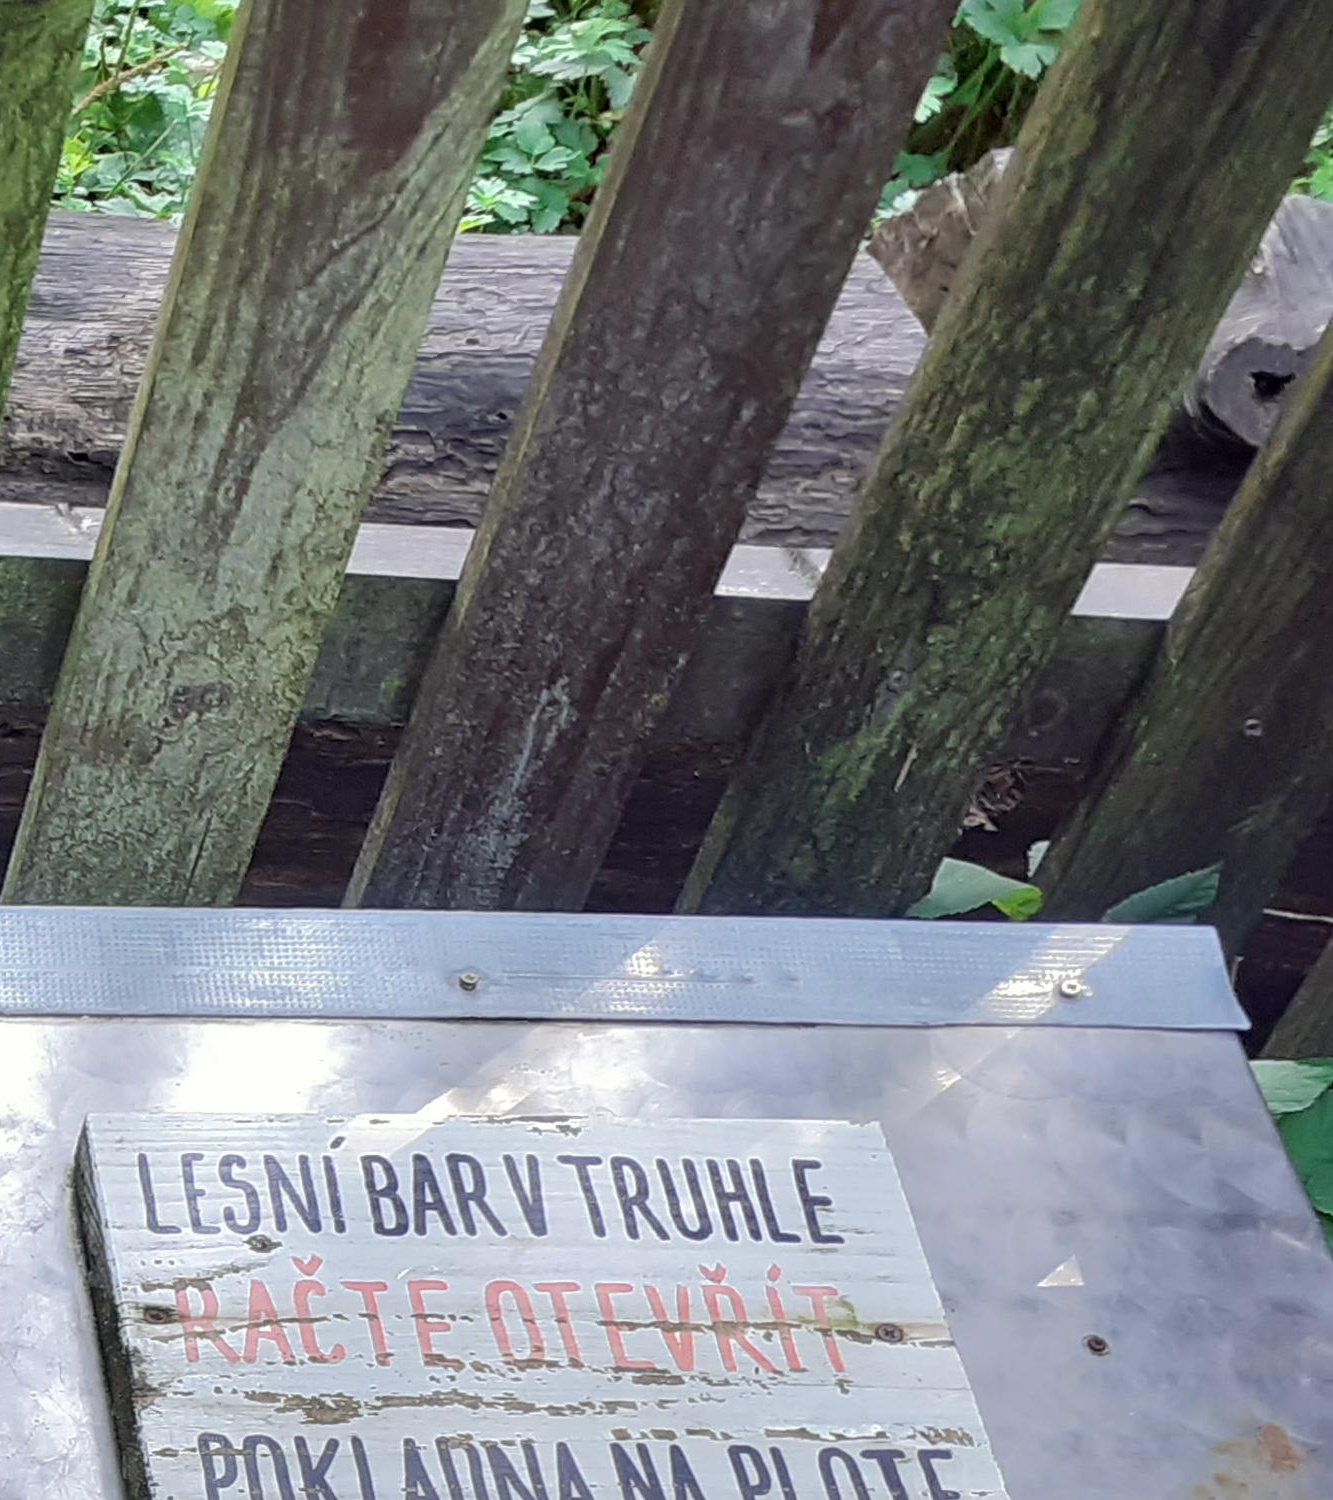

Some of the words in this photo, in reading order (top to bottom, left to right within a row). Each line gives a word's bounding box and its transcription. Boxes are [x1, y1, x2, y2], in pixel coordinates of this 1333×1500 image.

[138, 1135, 346, 1236] LESNÍ
[360, 1153, 507, 1238] BAR
[505, 1153, 550, 1238] V
[557, 1154, 845, 1245] TRUHLE
[178, 1255, 455, 1368] RAČTE
[486, 1264, 849, 1374] OTEVŘÍT
